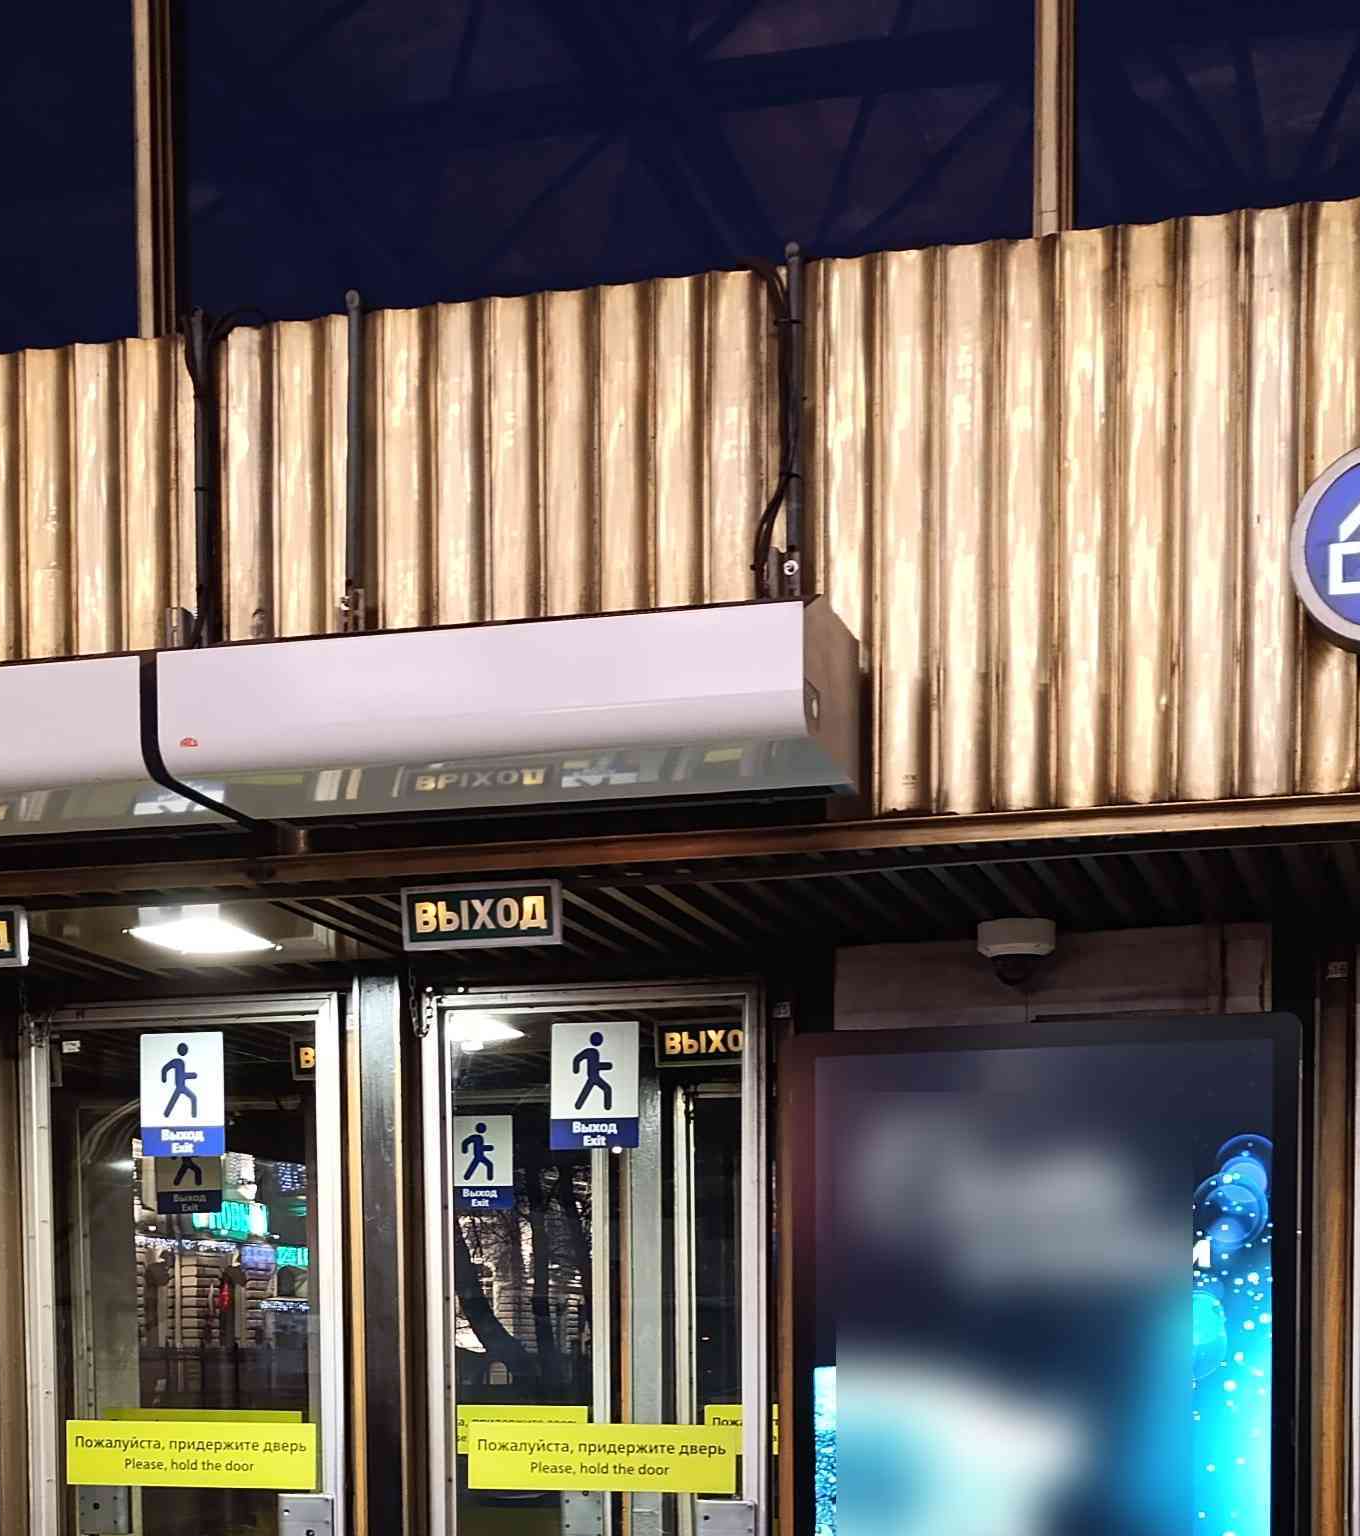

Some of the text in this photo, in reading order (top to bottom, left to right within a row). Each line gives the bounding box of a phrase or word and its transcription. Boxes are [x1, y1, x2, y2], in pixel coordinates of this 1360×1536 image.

[415, 895, 548, 934] ВЫХОД
[665, 1029, 744, 1055] ВЫХО
[572, 1121, 618, 1135] Выход
[171, 1142, 194, 1154] Exit
[583, 1135, 607, 1147] Exit
[462, 1188, 498, 1198] Выход
[471, 1198, 490, 1207] Exit
[75, 1435, 307, 1455] Пожалуйста, придержите дверь
[477, 1438, 574, 1455] Пожалуйста,
[578, 1442, 675, 1456] придержите
[679, 1443, 727, 1457] дверь
[125, 1459, 255, 1472] Please, hold the door
[530, 1462, 670, 1476] Please, hold the door
